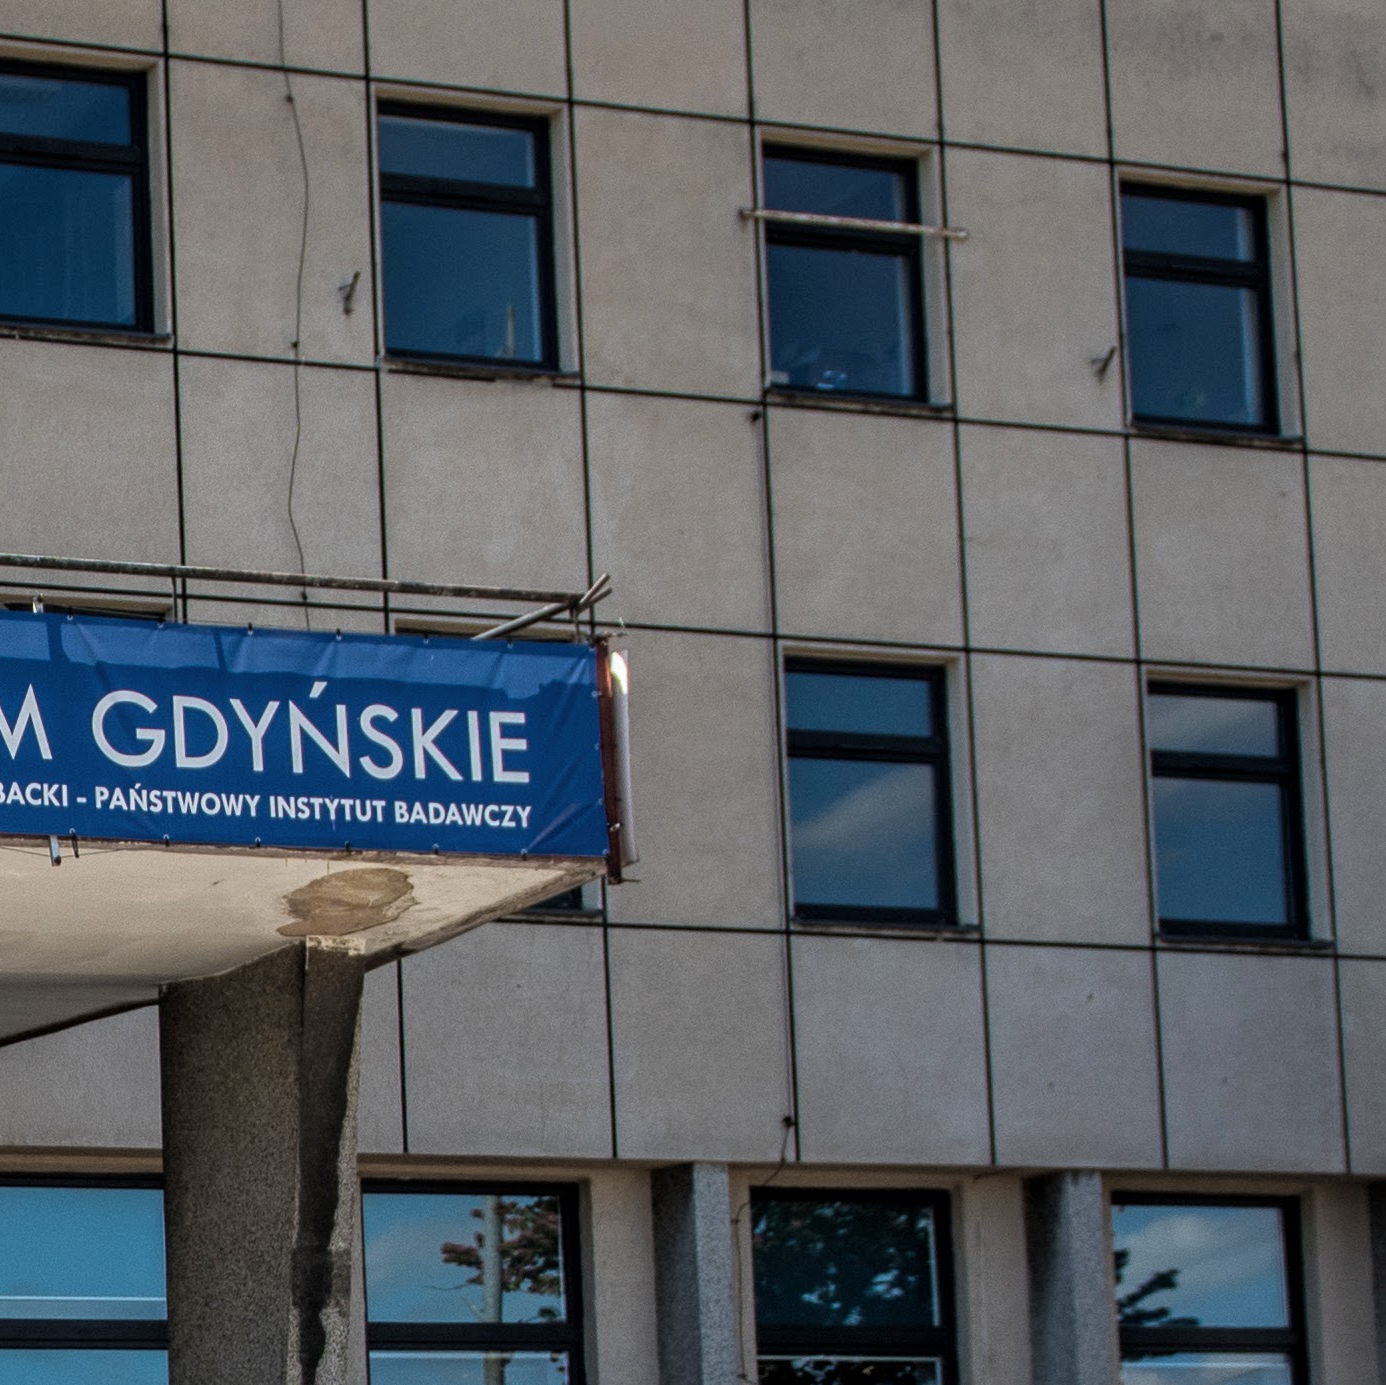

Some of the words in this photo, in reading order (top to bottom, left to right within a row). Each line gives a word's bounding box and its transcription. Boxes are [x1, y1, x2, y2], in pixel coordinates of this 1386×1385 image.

[90, 680, 531, 783] GDYŃSKIE
[94, 782, 261, 818] PAŃSTWOWY
[269, 795, 387, 823] INSTYTUT
[393, 801, 532, 829] BADAWCZY
